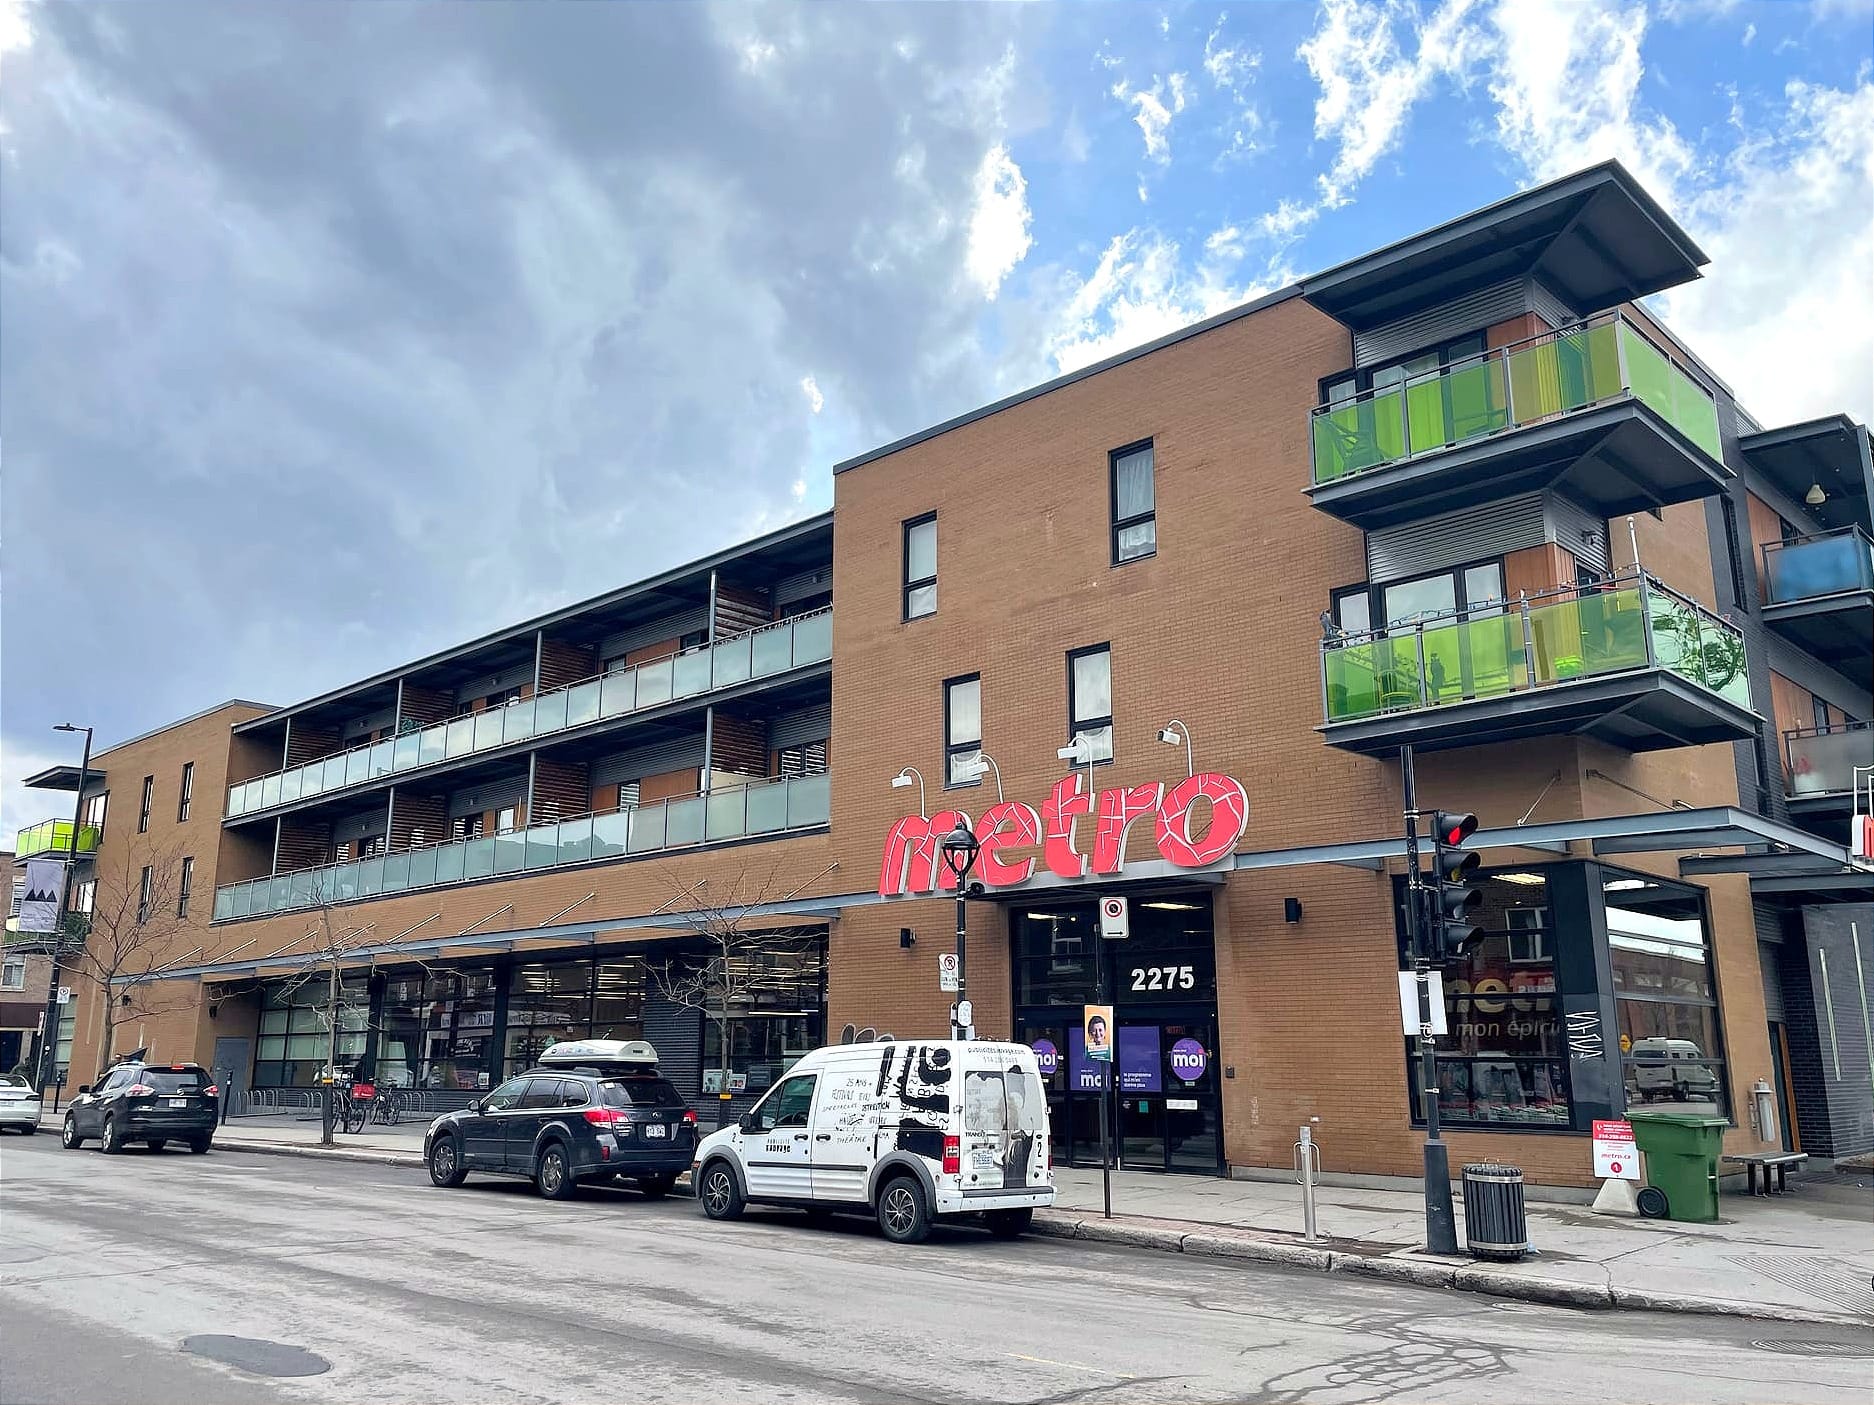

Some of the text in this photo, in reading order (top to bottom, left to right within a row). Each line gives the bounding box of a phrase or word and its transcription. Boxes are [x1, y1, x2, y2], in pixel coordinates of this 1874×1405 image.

[879, 773, 1249, 895] metro
[1131, 966, 1194, 991] 2275
[1456, 1022, 1499, 1037] mon
[1173, 1050, 1204, 1067] moi
[732, 1131, 737, 1143] 2
[1037, 1141, 1042, 1158] 2
